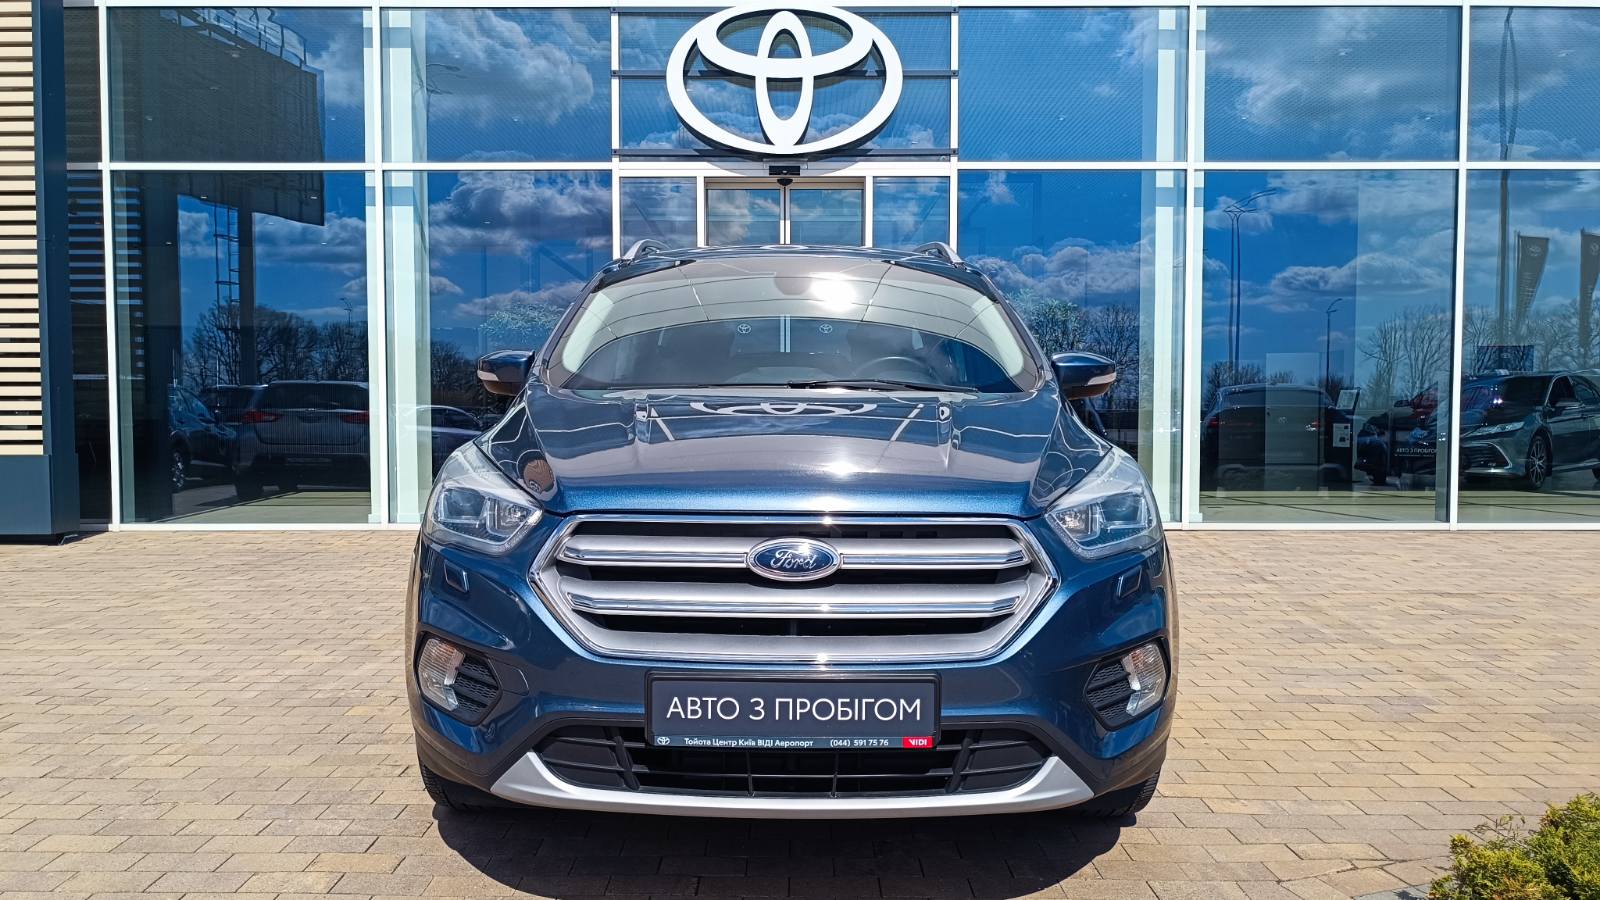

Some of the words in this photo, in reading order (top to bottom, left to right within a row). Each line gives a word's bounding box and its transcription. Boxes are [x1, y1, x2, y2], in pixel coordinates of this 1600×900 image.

[770, 549, 817, 569] Ford
[666, 697, 740, 720] АВТО
[775, 698, 921, 721] ПРОБІГОМ
[684, 737, 711, 746] Тойота
[712, 738, 737, 747] Центр
[738, 738, 757, 746] Київ
[757, 738, 773, 747] ВІДІ
[774, 739, 814, 748] Аеропорт
[830, 738, 851, 747] (044)
[853, 739, 867, 747] 591
[868, 739, 878, 747] 75
[879, 739, 889, 747] 76
[908, 738, 928, 746] VIDI
